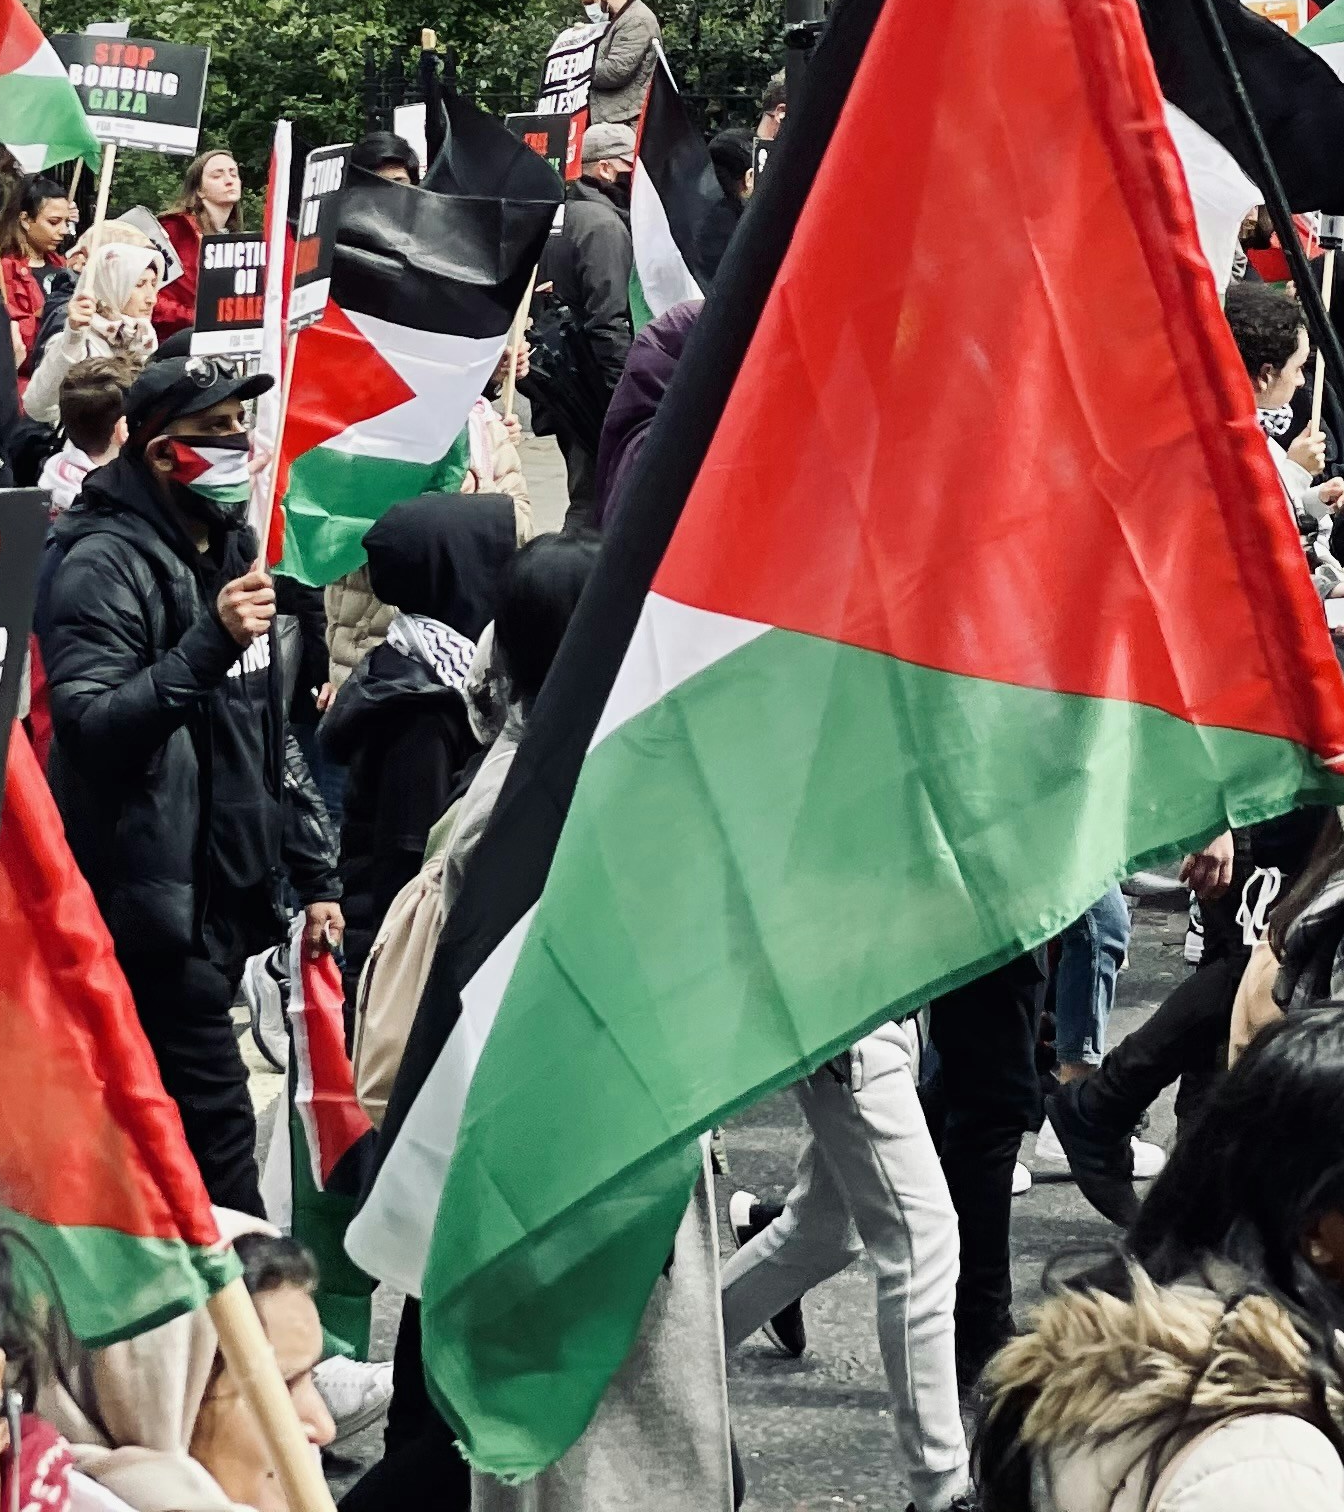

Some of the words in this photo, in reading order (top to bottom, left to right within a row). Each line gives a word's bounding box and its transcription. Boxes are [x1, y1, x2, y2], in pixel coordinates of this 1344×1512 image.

[95, 43, 155, 69] STOP
[69, 63, 179, 96] BOMBING
[88, 88, 147, 114] GAZA
[204, 242, 266, 270] SANCTI
[234, 269, 257, 295] ON
[217, 297, 265, 322] ISRAE
